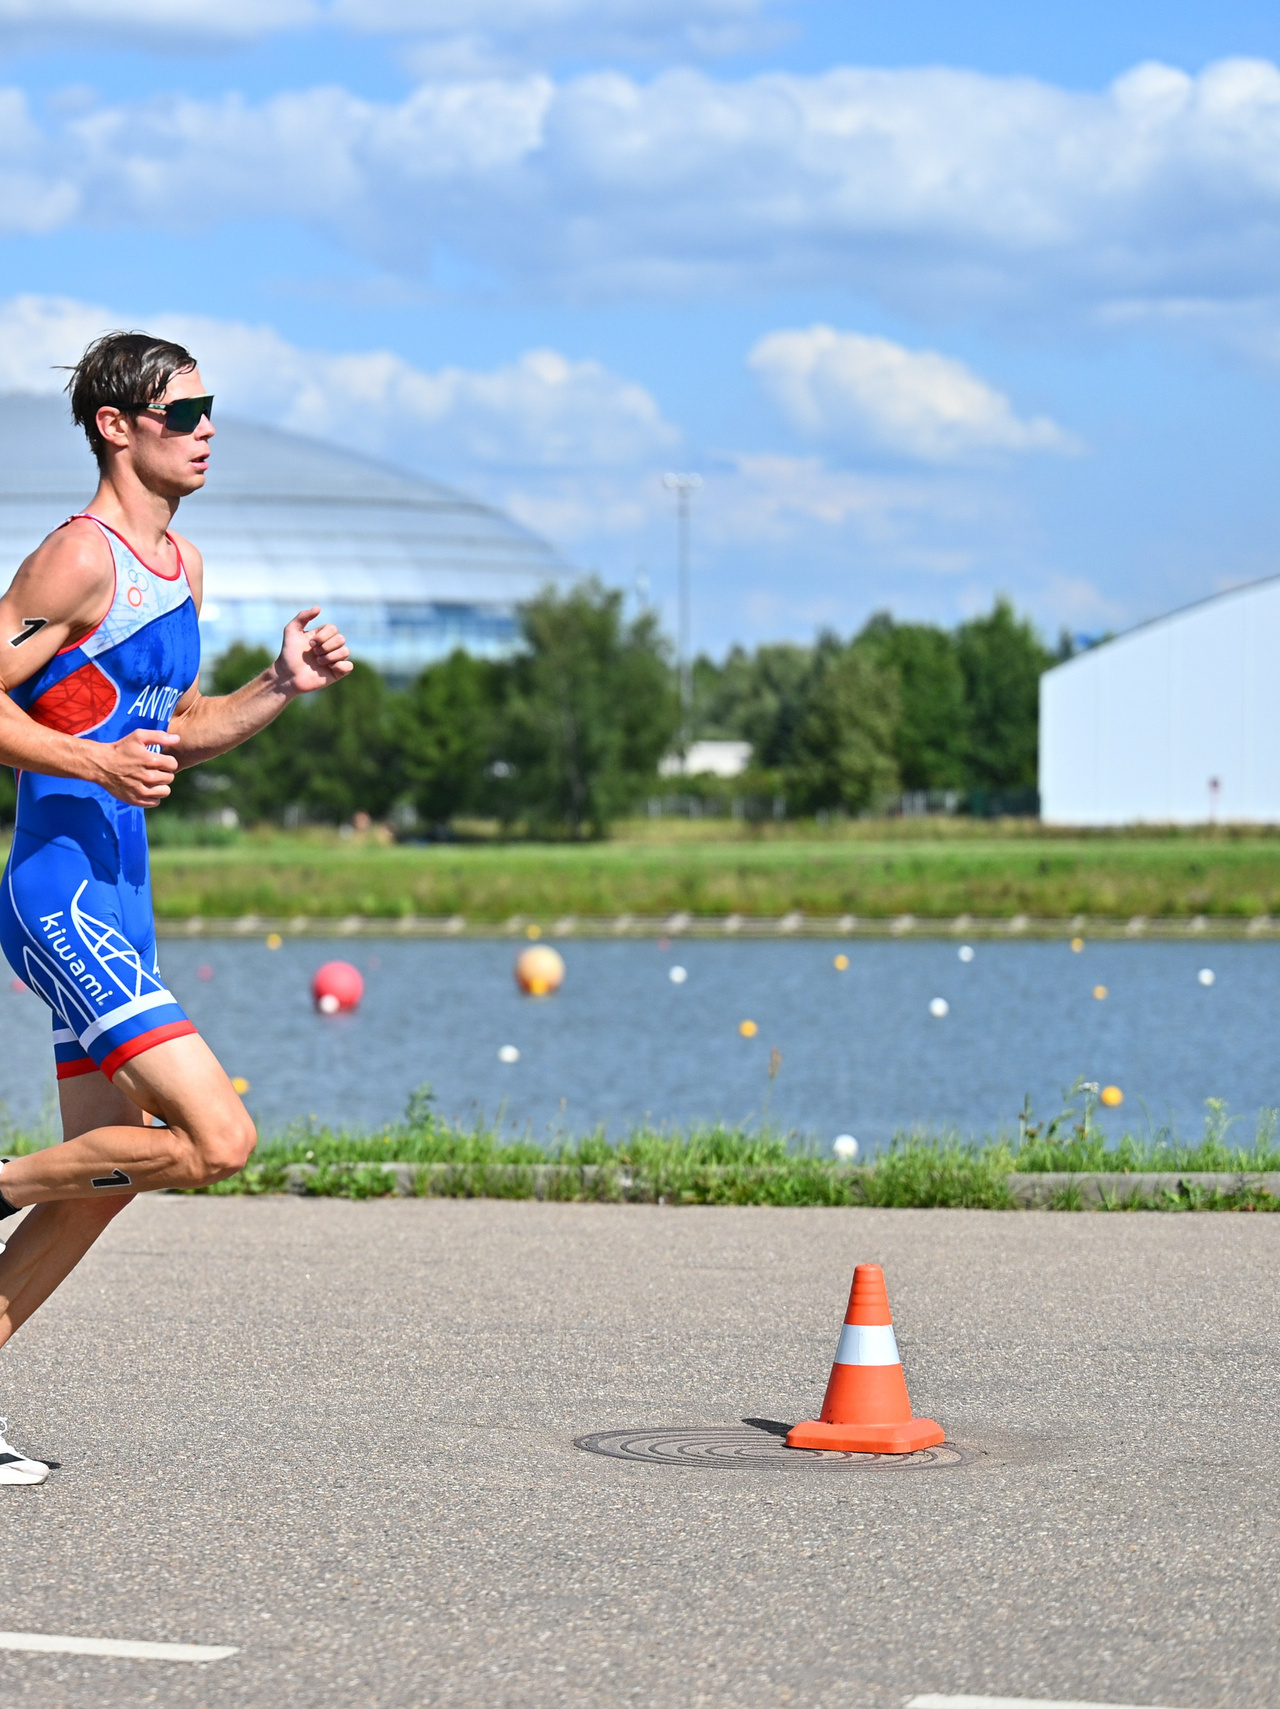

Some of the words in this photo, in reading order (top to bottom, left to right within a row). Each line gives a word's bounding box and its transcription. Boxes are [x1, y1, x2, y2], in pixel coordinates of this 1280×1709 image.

[9, 617, 49, 648] 1
[39, 910, 113, 1003] kiwami
[90, 1168, 132, 1189] 1
